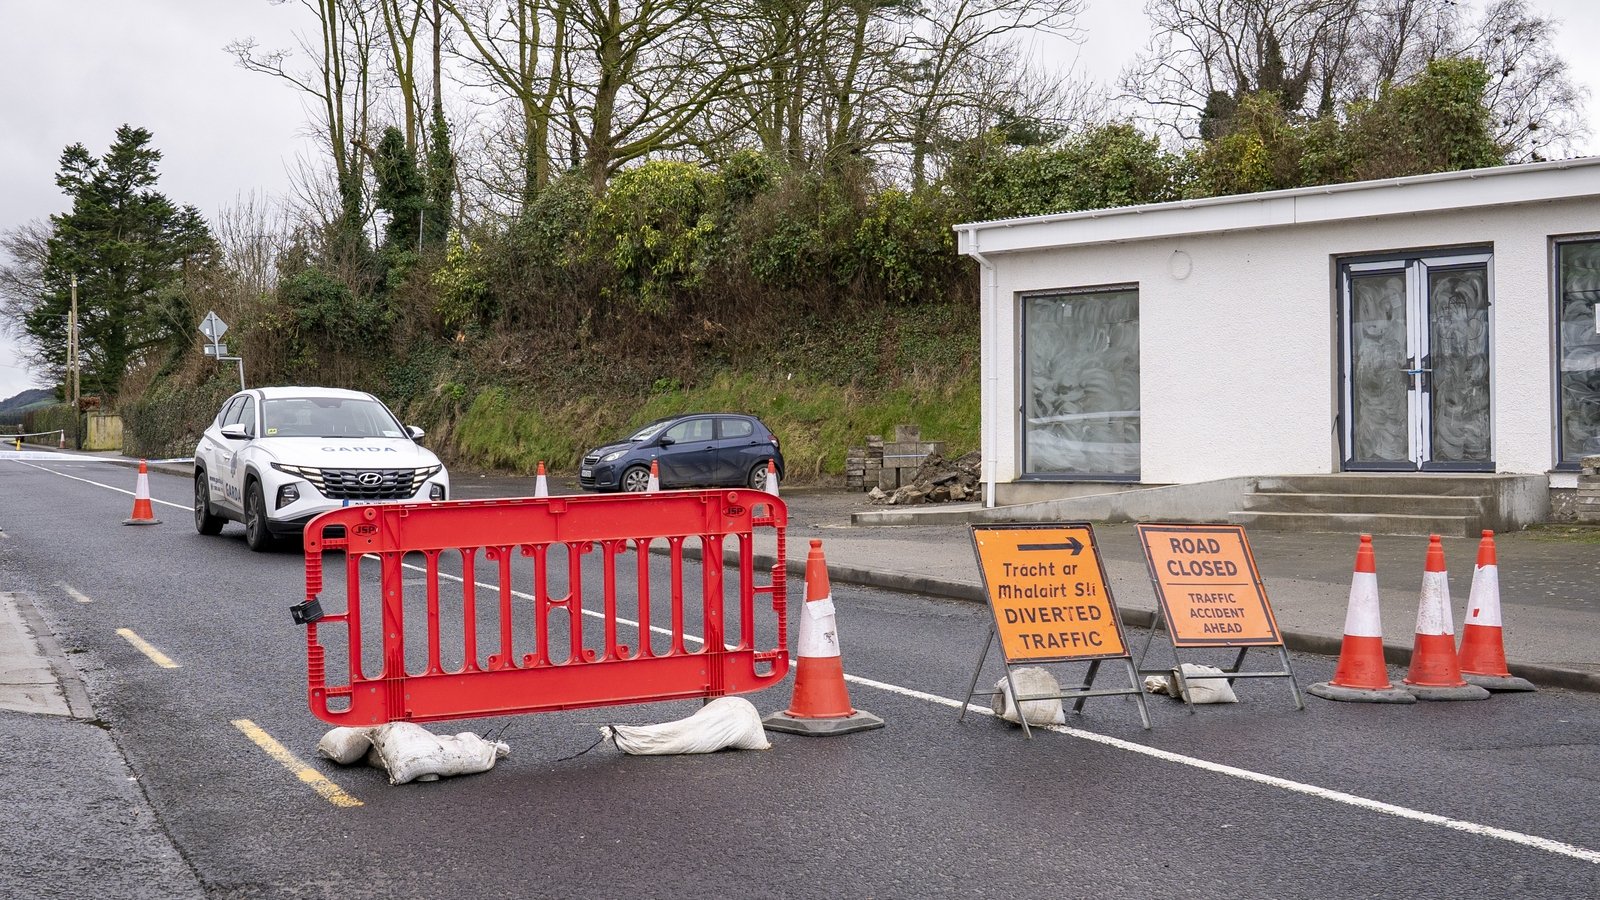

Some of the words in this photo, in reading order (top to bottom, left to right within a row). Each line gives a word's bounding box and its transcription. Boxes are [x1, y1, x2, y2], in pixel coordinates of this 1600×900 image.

[226, 483, 242, 503] GARDA
[726, 507, 743, 515] JSP
[356, 525, 375, 533] JSP
[1169, 538, 1220, 553] ROAD
[1063, 564, 1078, 575] ar
[1167, 560, 1237, 576] CLOSED
[998, 583, 1066, 599] Mhalairt
[1188, 593, 1236, 603] TRAFFIC
[1004, 605, 1102, 624] DIVERTED
[1190, 608, 1245, 618] ACCIDENT
[1204, 623, 1243, 633] AHEAD
[1019, 631, 1103, 649] TRAFFIC
